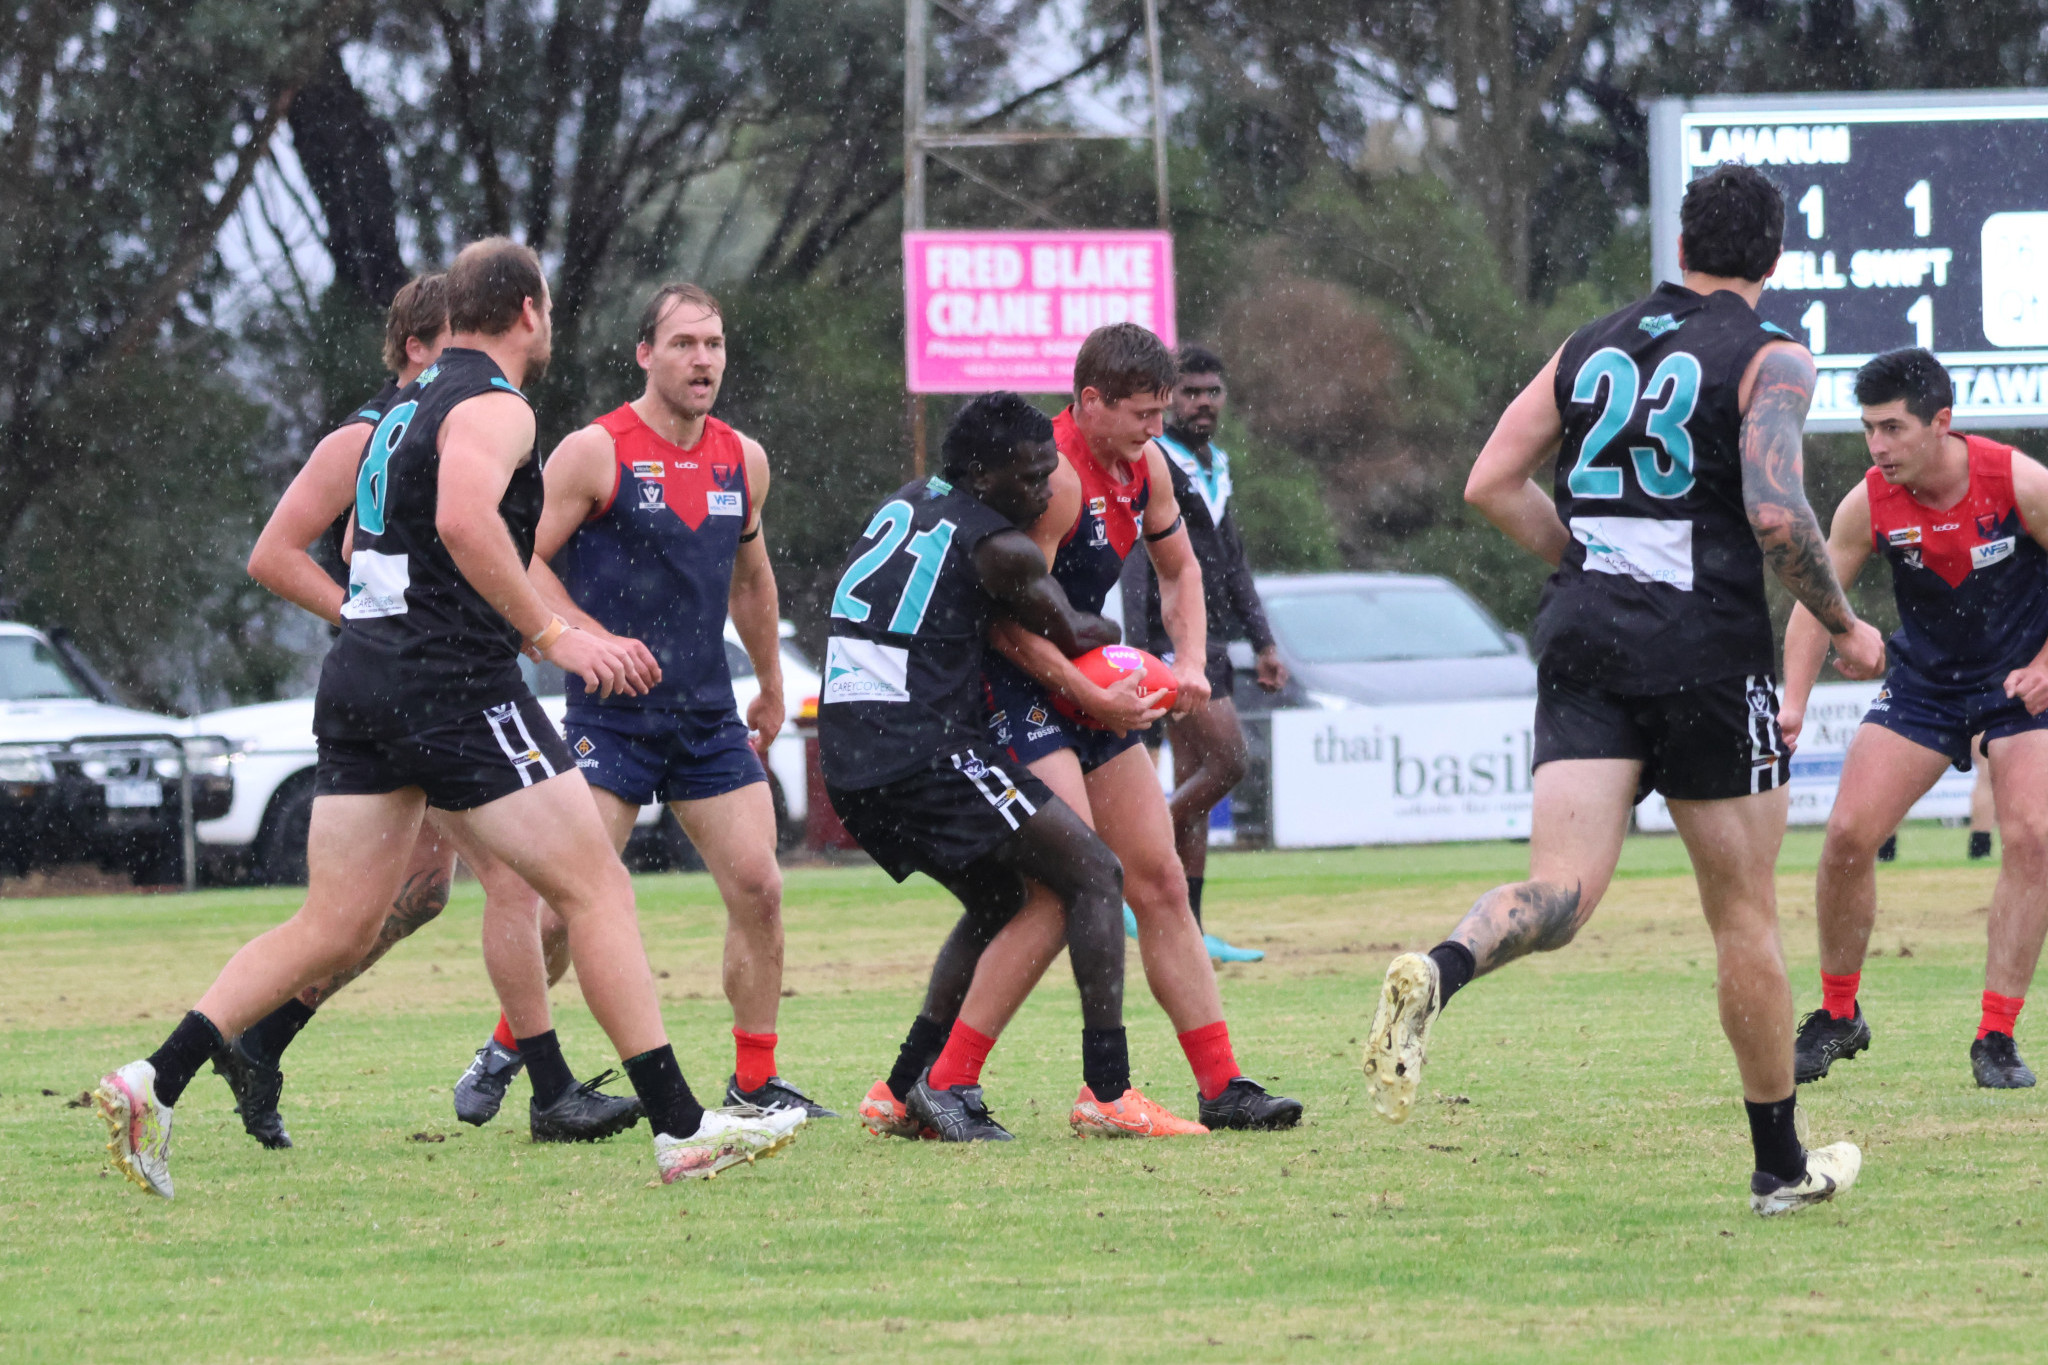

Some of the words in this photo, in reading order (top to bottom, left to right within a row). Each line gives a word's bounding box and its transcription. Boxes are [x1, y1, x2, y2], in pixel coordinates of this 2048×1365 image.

[1798, 185, 1825, 239] 1
[1904, 180, 1932, 237] 1
[926, 246, 1024, 289] FRED
[1032, 245, 1154, 288] BLAKE
[1850, 247, 1954, 288] SWIFT
[926, 293, 1053, 336] CRANE
[1800, 301, 1826, 354] 1
[1907, 295, 1933, 352] 1
[1568, 347, 1702, 499] 23
[830, 500, 957, 635] 21
[1314, 725, 1382, 764] thai
[1391, 729, 1534, 799] basil
